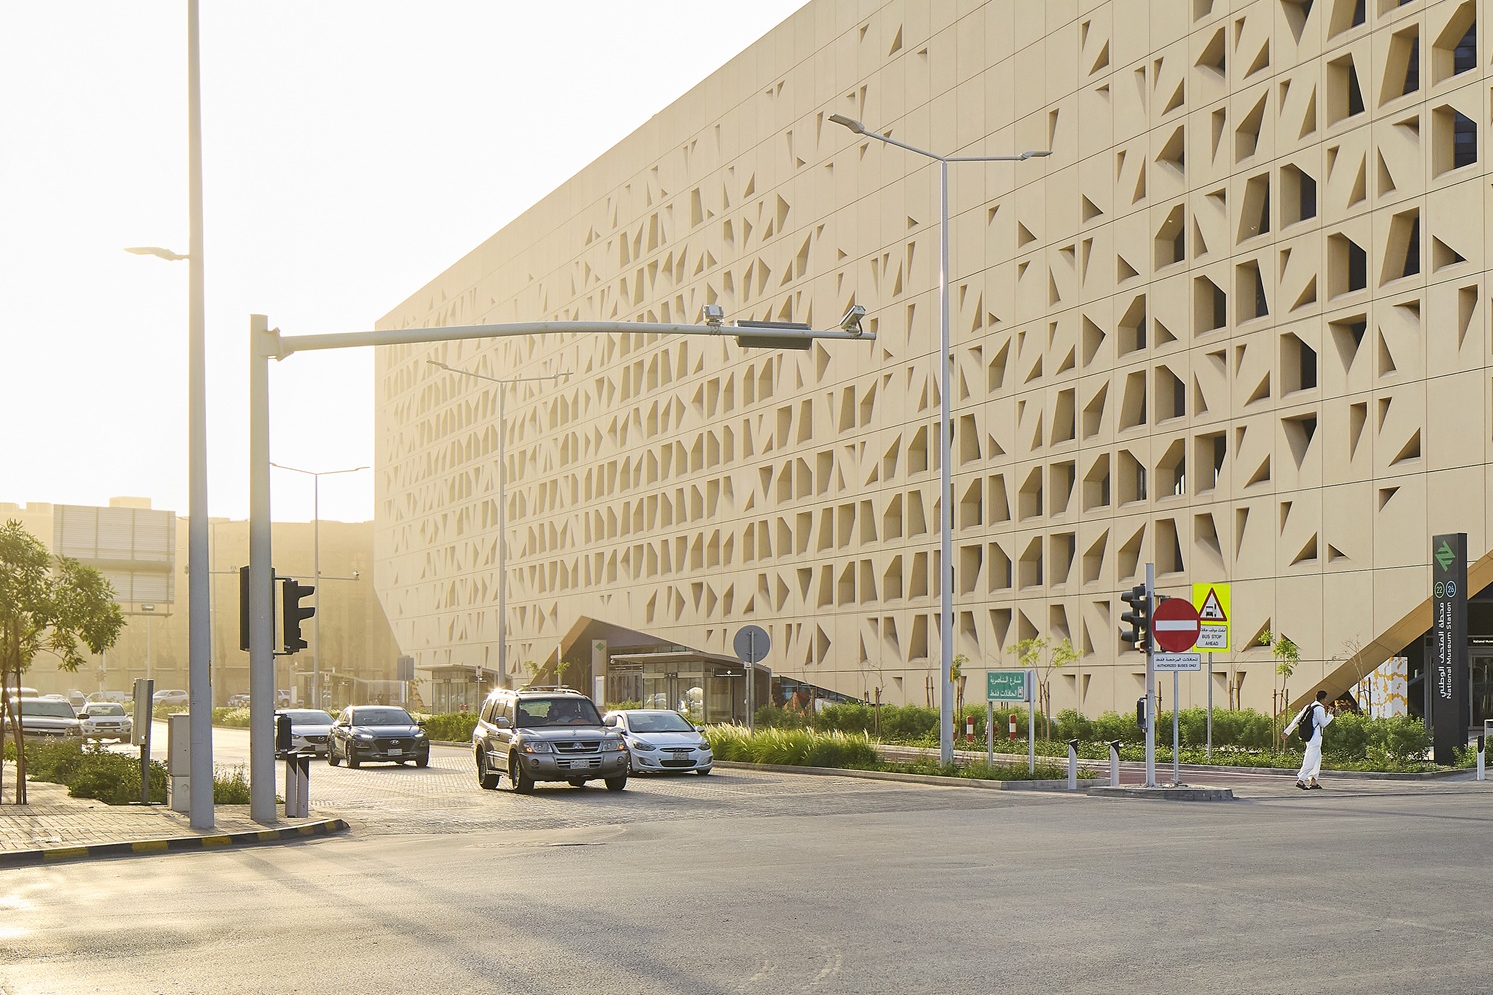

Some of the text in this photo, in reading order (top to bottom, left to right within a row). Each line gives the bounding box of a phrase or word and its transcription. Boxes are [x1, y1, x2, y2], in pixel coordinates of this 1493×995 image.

[1436, 586, 1442, 594] 22
[1009, 675, 1022, 686] شارع
[1438, 666, 1446, 698] الوطني
